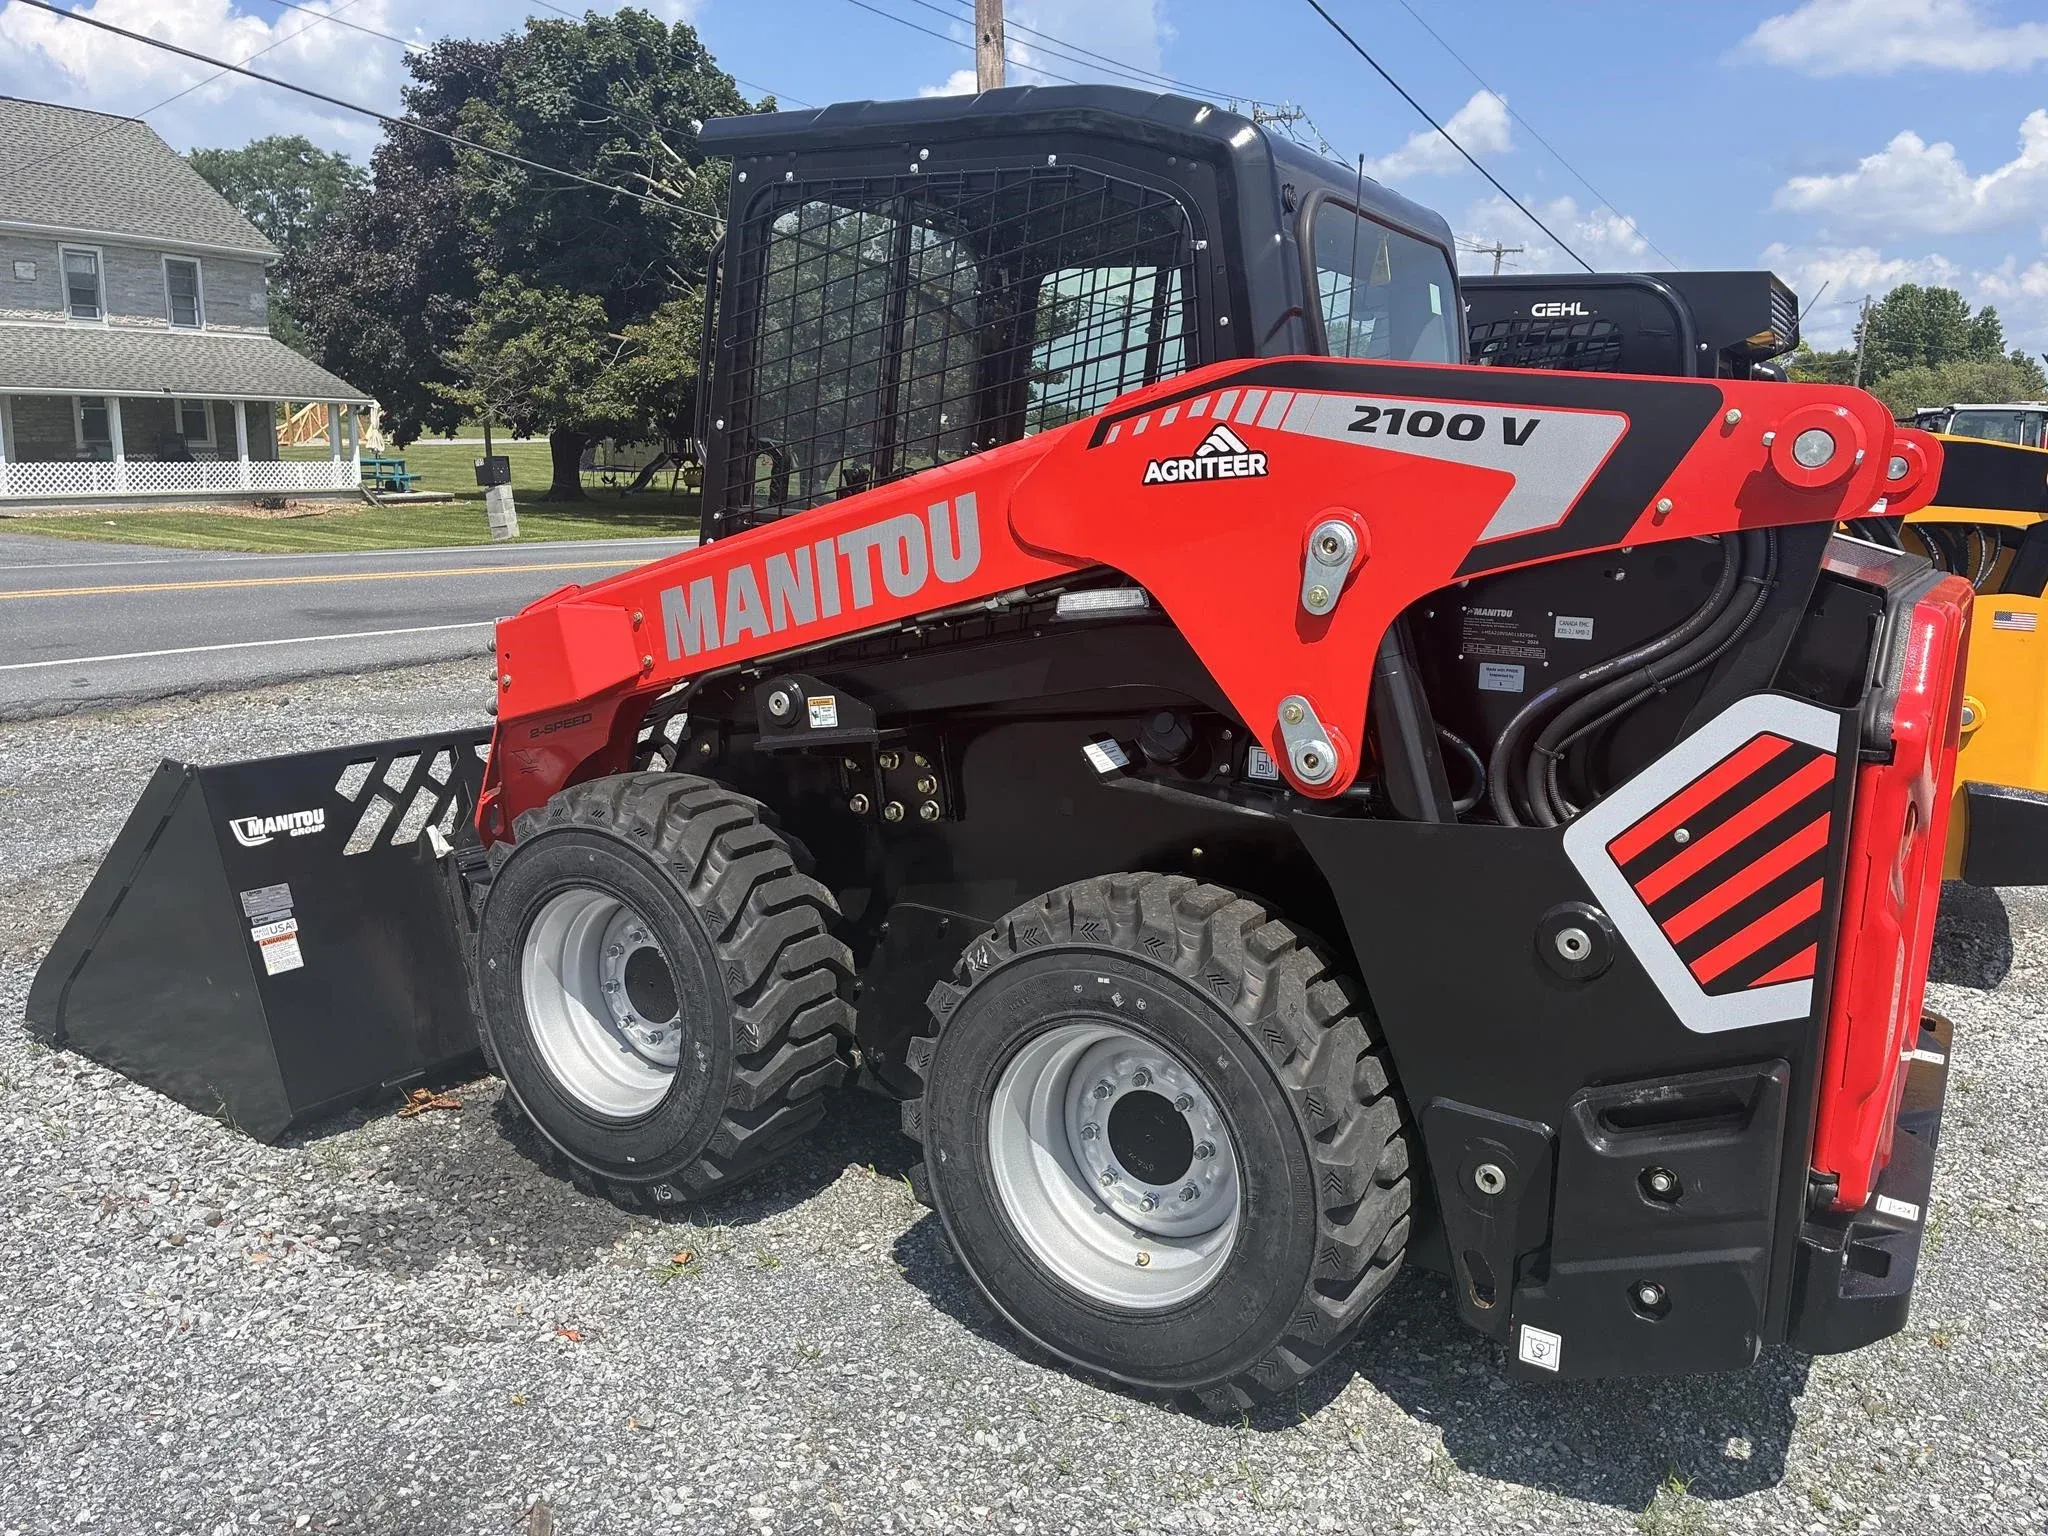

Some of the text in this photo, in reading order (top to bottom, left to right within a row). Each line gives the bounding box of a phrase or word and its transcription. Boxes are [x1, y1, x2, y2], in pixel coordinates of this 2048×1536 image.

[1531, 301, 1589, 317] GEHL
[1347, 405, 1541, 447] 2100 V
[1143, 453, 1267, 484] AGRITEER
[659, 491, 981, 662] MANITOU
[1473, 607, 1513, 618] MANITOU
[529, 713, 592, 738] 2-SPEED
[247, 808, 325, 837] MANITOU
[289, 823, 326, 837] GROUP
[269, 922, 293, 935] USA
